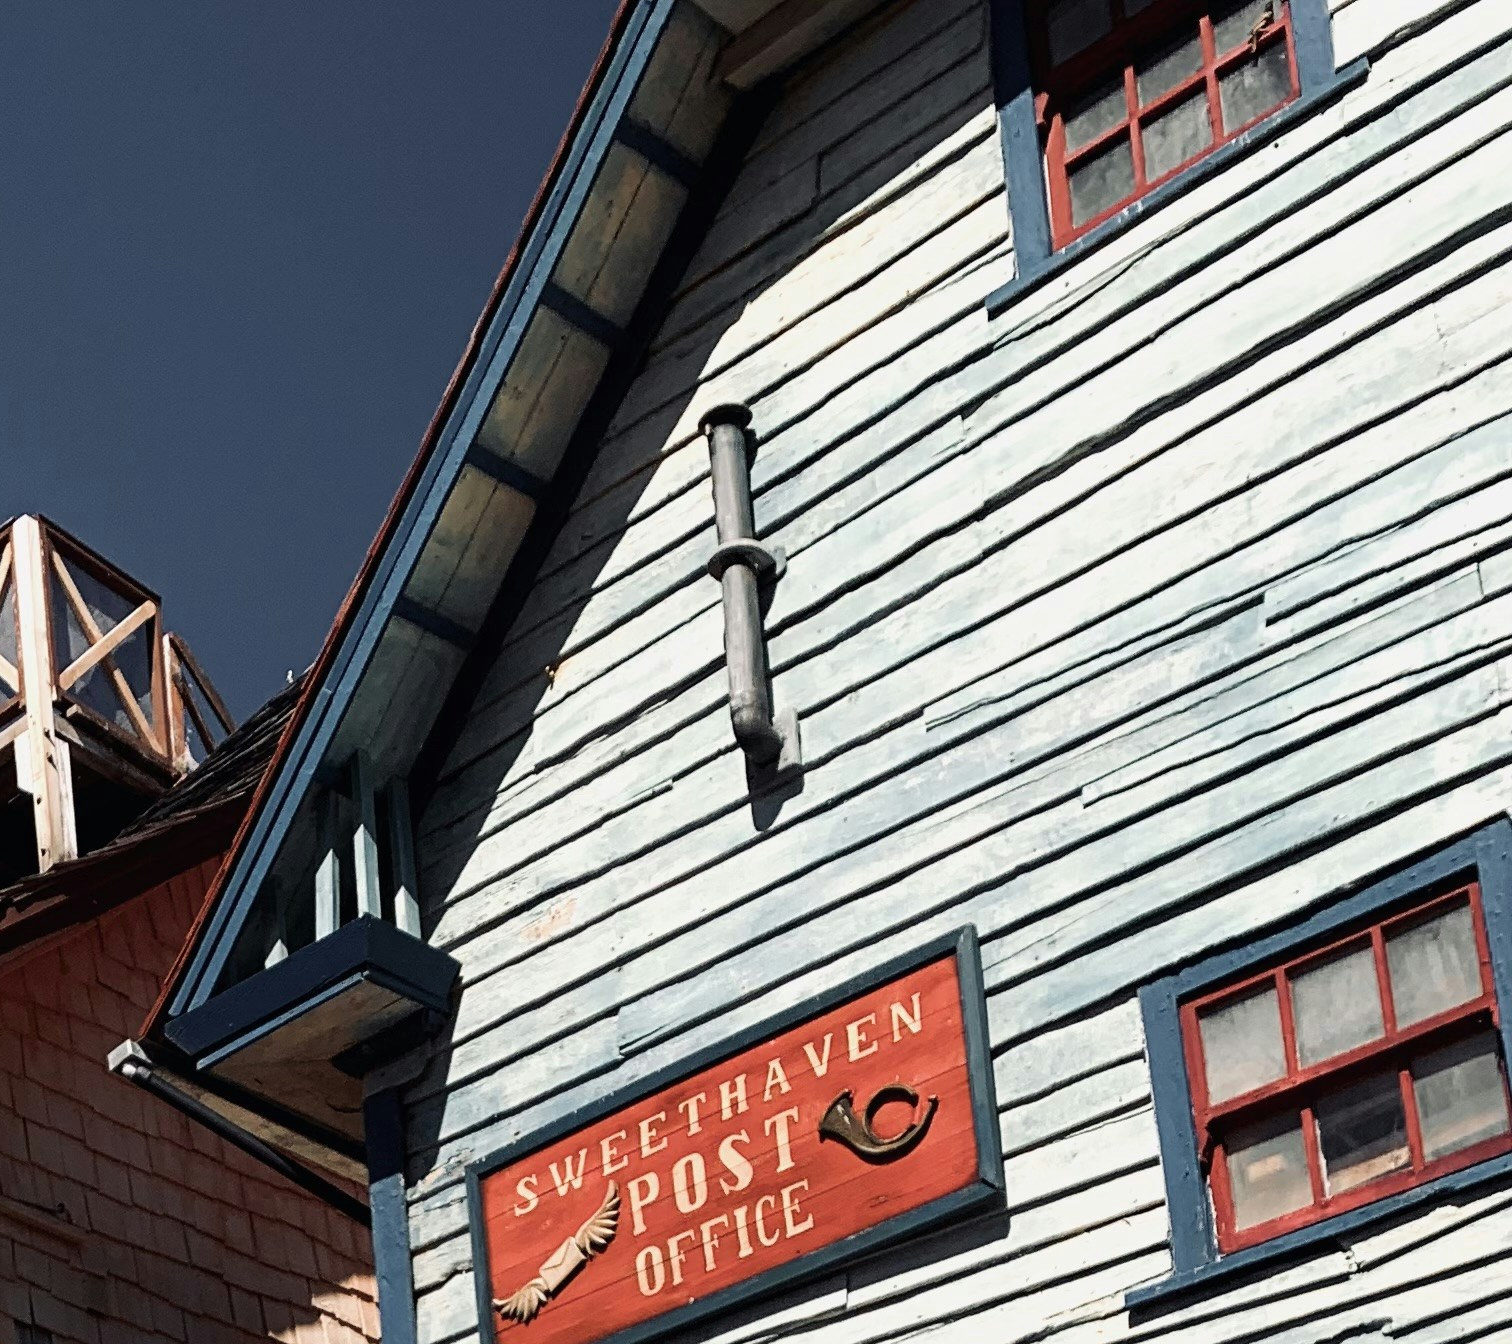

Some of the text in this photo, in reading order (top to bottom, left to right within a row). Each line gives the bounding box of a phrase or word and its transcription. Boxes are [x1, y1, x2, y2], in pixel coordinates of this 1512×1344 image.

[513, 992, 923, 1217] SWEETHAVEN
[626, 1106, 801, 1236] POST
[635, 1179, 815, 1297] OFFICE
